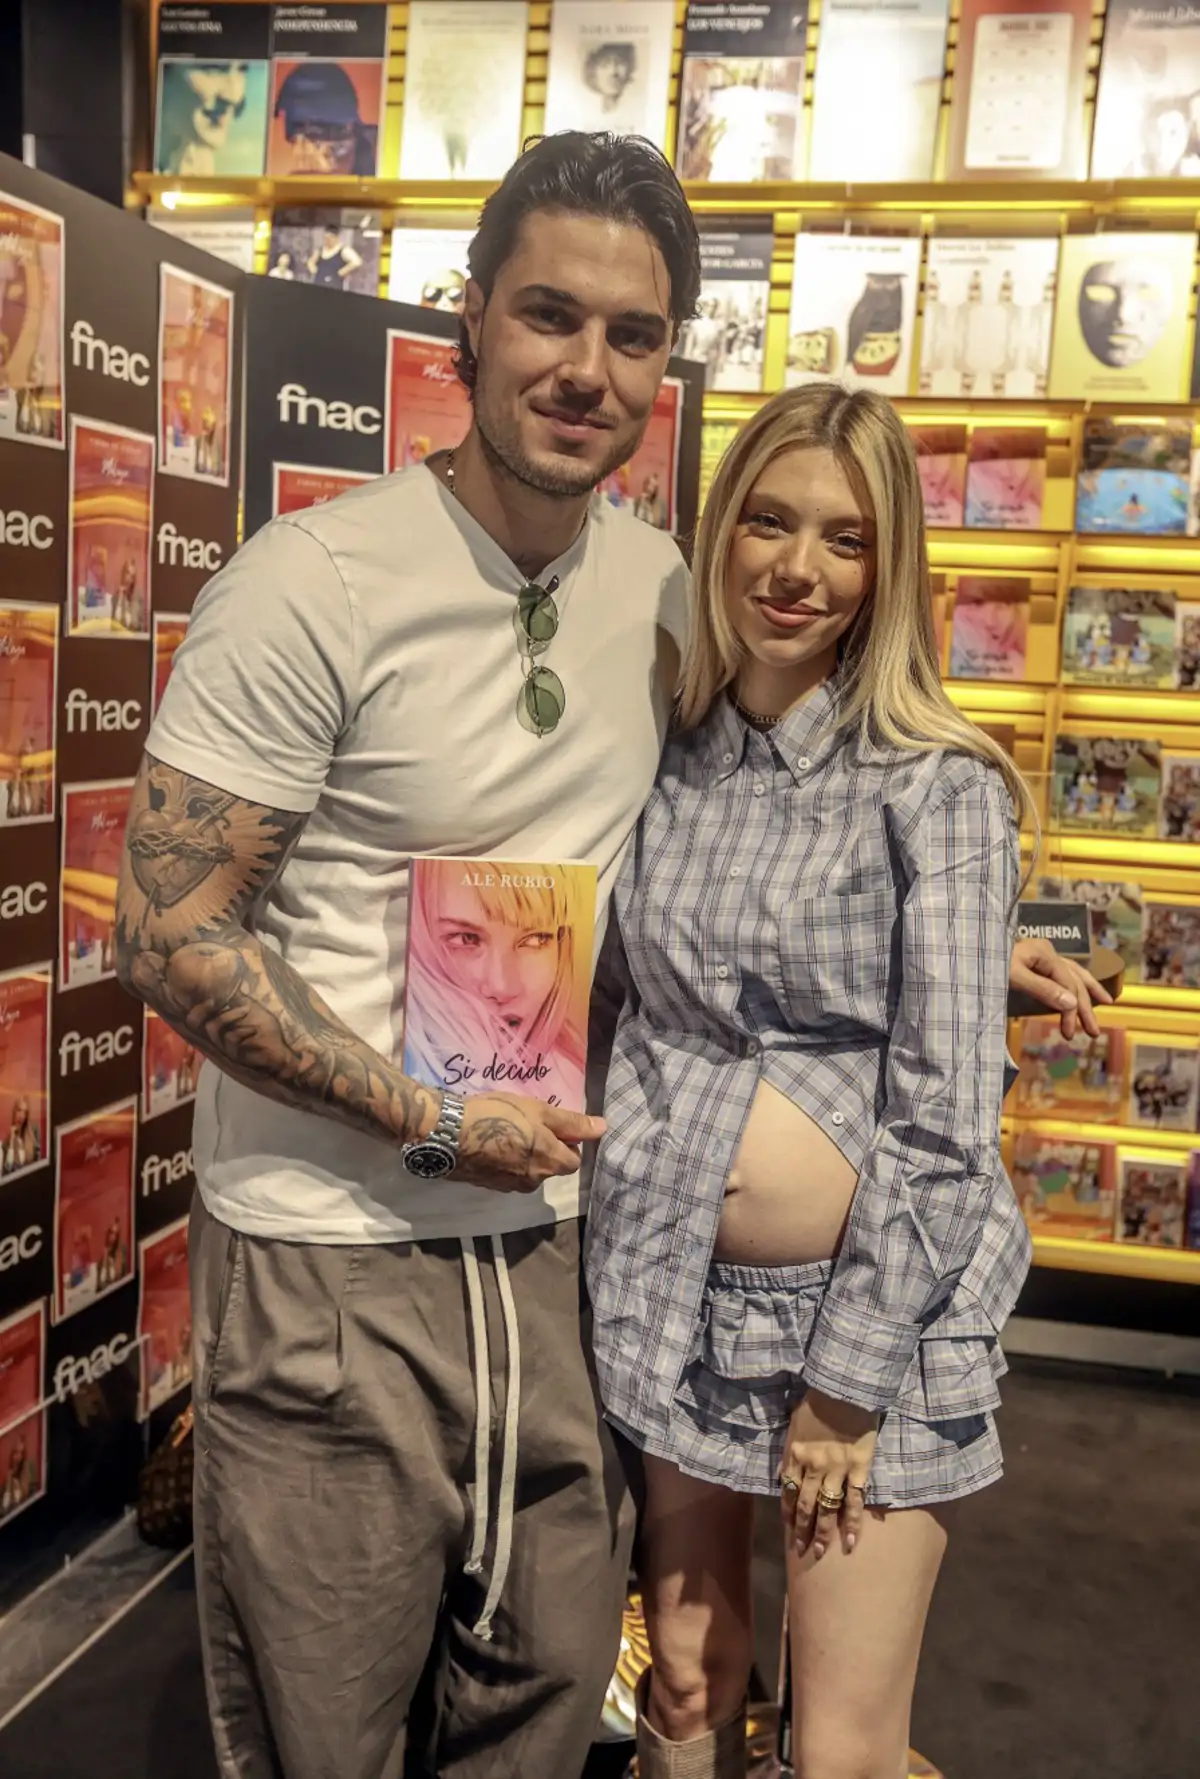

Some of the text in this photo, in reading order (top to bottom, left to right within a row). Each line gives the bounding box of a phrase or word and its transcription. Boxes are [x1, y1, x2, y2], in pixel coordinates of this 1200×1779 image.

[70, 320, 150, 387] fnac
[276, 383, 382, 435] fnac
[157, 522, 222, 572] fnac
[65, 688, 142, 733] fnac
[460, 872, 556, 890] ALE RUBIO
[58, 1024, 134, 1077] fnac
[443, 1052, 552, 1085] Si decido
[53, 1333, 129, 1403] fnac
